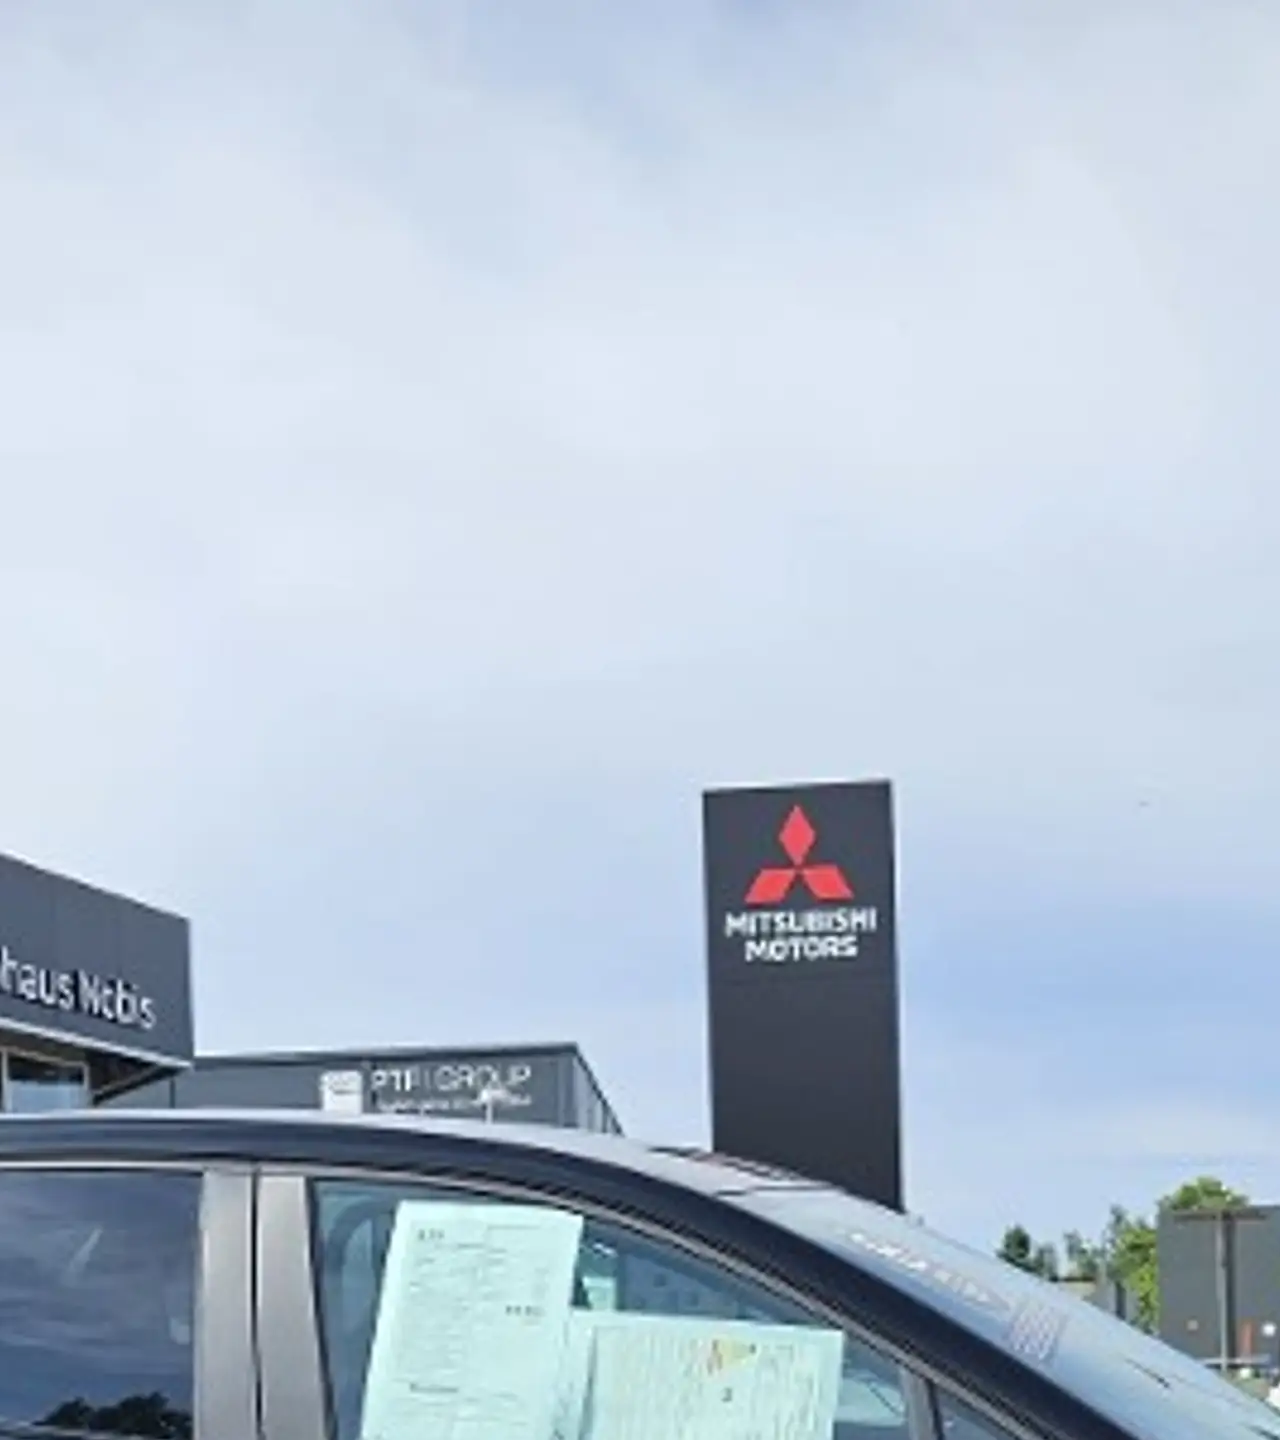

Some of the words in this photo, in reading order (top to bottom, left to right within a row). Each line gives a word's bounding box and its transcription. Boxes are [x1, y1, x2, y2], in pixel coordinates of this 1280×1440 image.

[725, 907, 877, 937] MITSUBISHI
[744, 934, 859, 962] MOTORS
[78, 969, 157, 1029] Nobis
